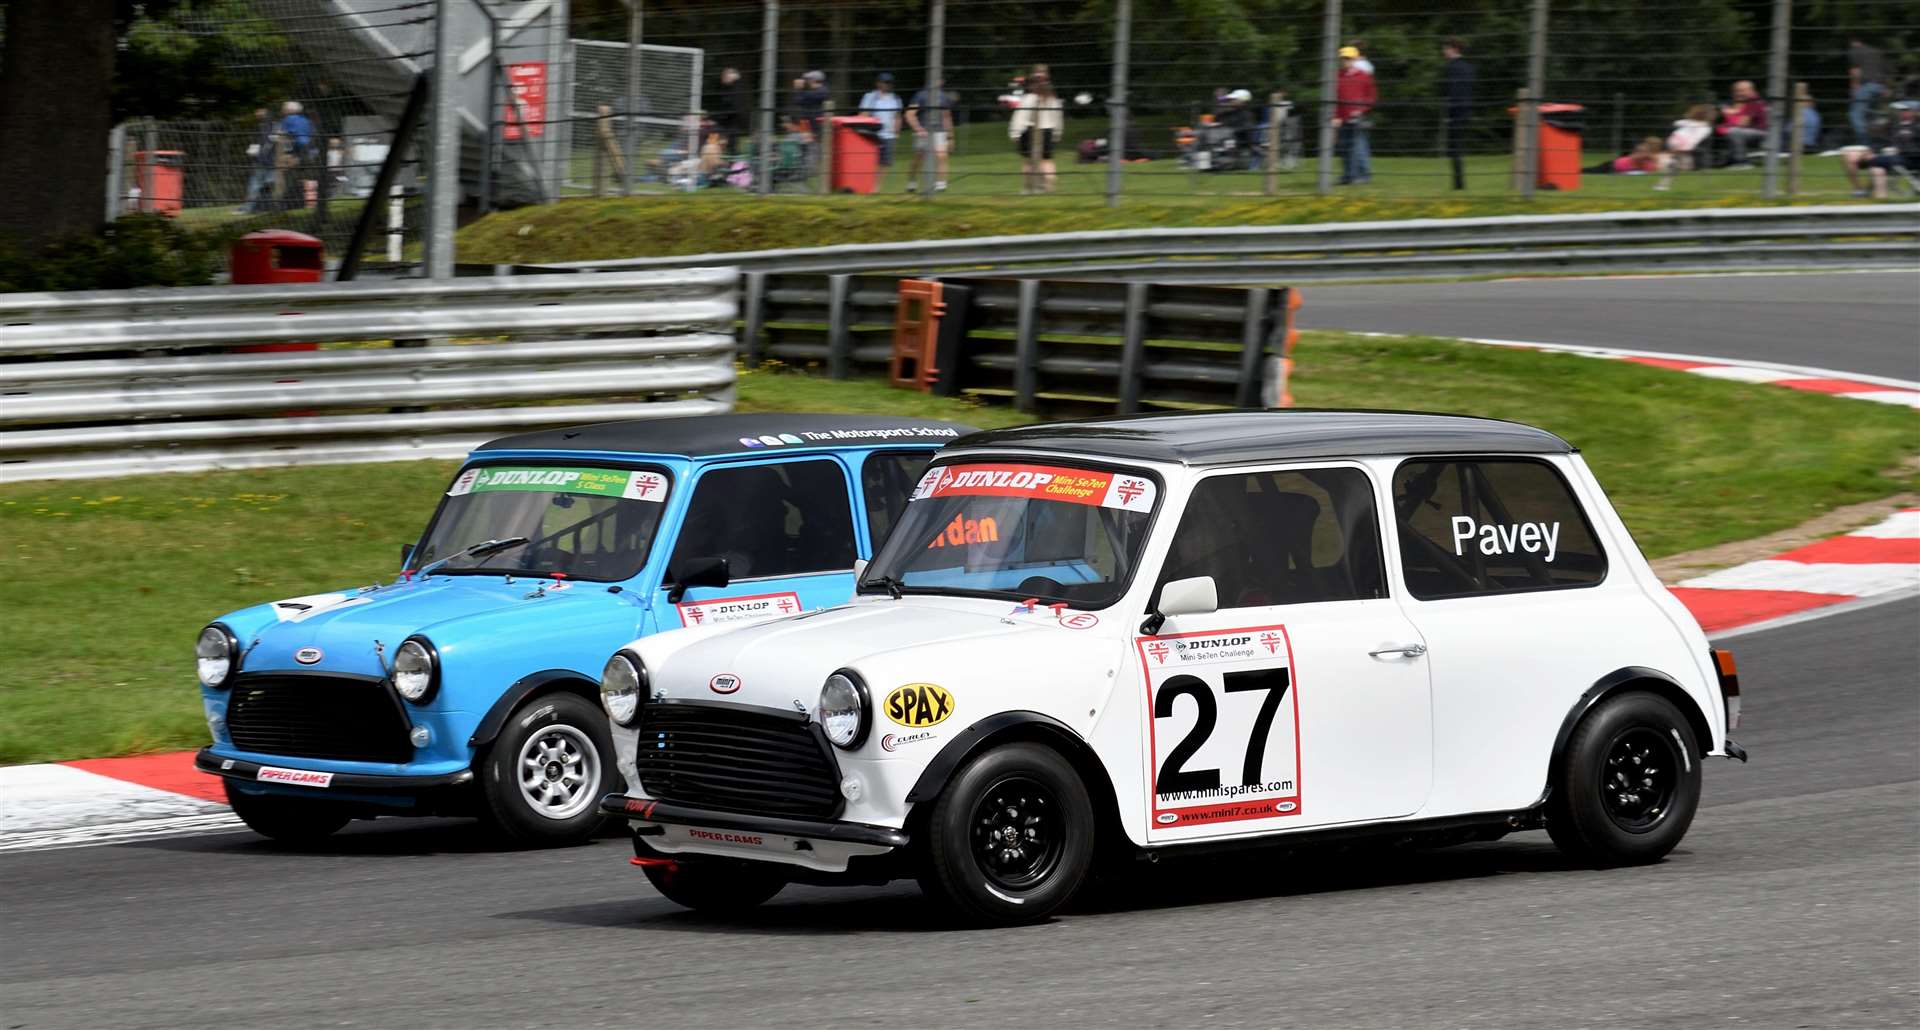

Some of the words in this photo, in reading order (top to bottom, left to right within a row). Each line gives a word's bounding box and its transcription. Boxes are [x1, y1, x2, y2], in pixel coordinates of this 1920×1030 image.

[802, 431, 830, 441] The
[831, 428, 913, 440] Motorsports
[912, 427, 959, 438] School
[488, 470, 580, 486] DUNLOP
[951, 470, 1053, 489] DUNLOP
[1052, 475, 1075, 485] Mini
[1076, 478, 1107, 489] Se7en
[1046, 484, 1094, 497] Challenge
[1451, 515, 1560, 562] Pavey
[720, 602, 770, 614] DUNLOP
[1190, 637, 1251, 650] DUNLOP
[1180, 653, 1196, 661] Mini
[1199, 651, 1218, 660] Se7en
[1220, 648, 1255, 658] Challenge
[890, 686, 949, 725] SPAX
[1155, 667, 1290, 795] 27
[261, 769, 292, 781] PIPER
[292, 773, 328, 784] CAMS
[1160, 779, 1293, 802] www.minispares.com
[1182, 803, 1273, 822] www.mini7.co.uk
[689, 829, 724, 841] PIPER
[724, 834, 763, 845] CAMS
